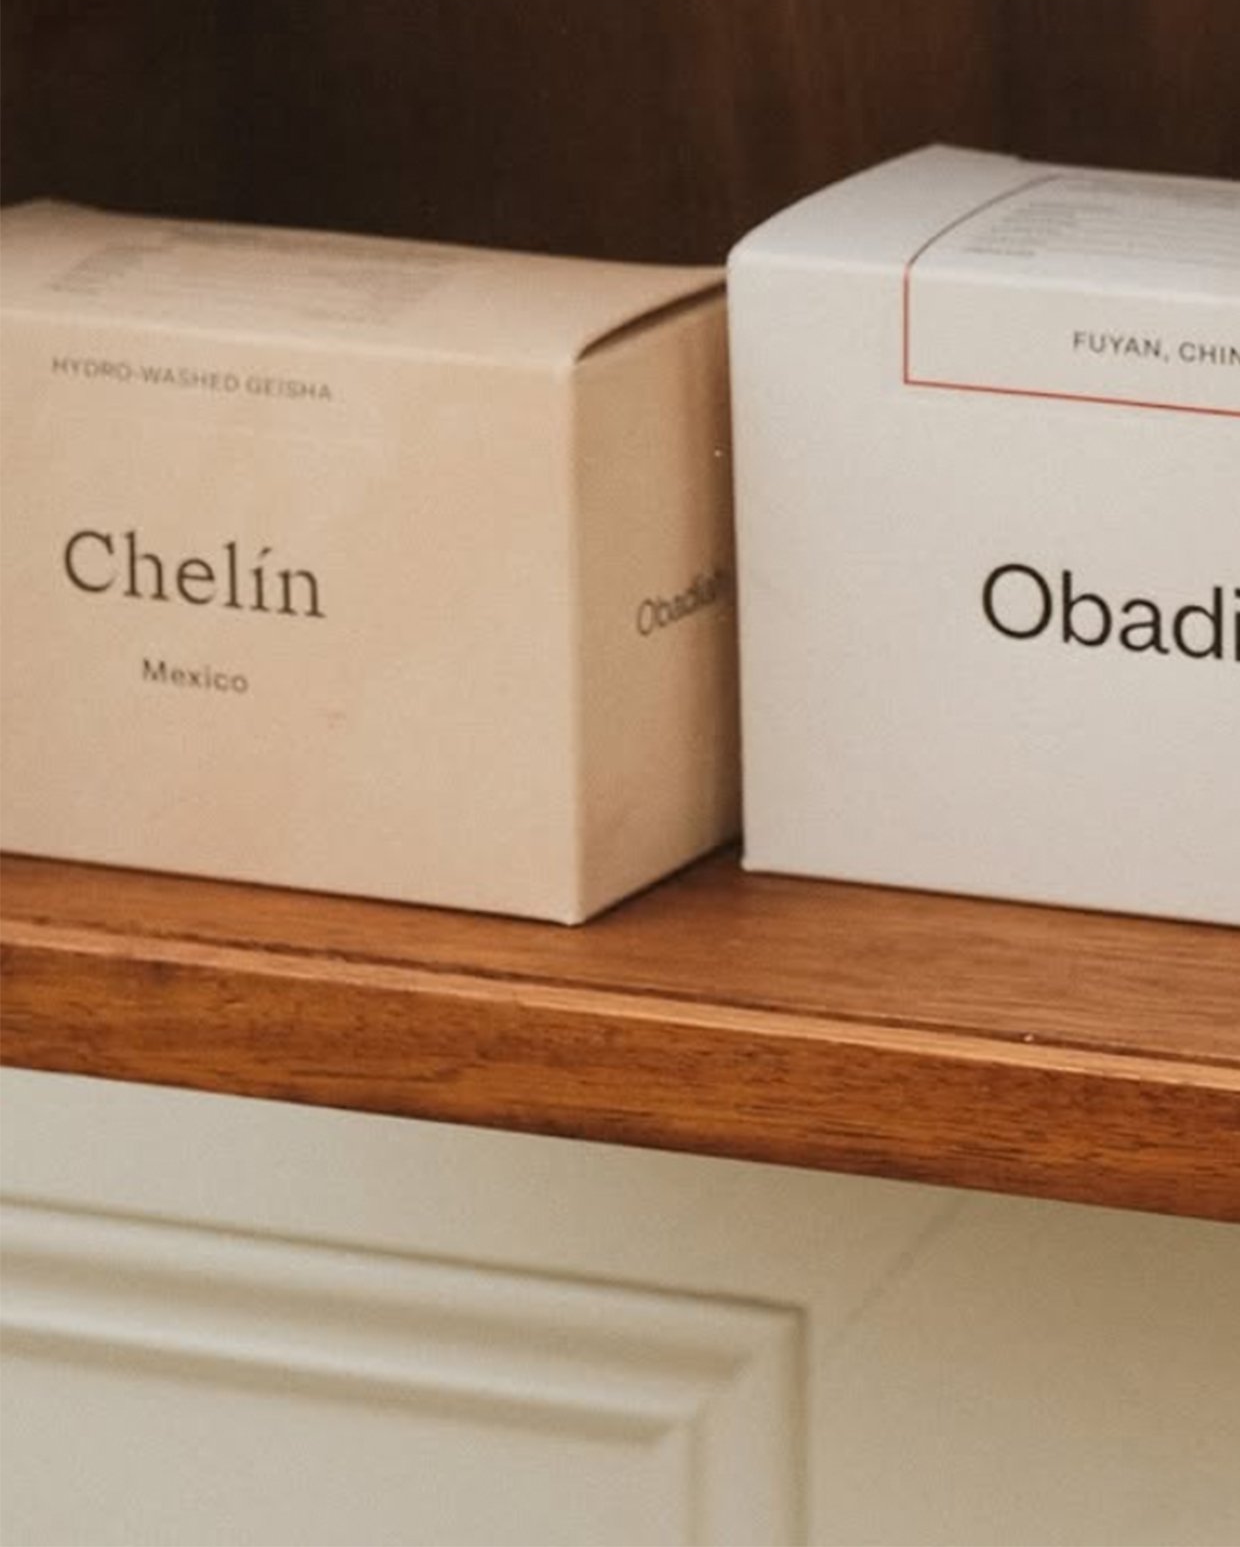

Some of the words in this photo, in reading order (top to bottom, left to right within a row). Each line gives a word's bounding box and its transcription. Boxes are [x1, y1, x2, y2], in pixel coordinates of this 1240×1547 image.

[1072, 330, 1170, 364] FUYAN,
[51, 356, 240, 392] HYDRO-WASHED
[245, 375, 332, 402] GEISHA
[64, 529, 327, 619] Chelín
[142, 657, 249, 694] Mexico
